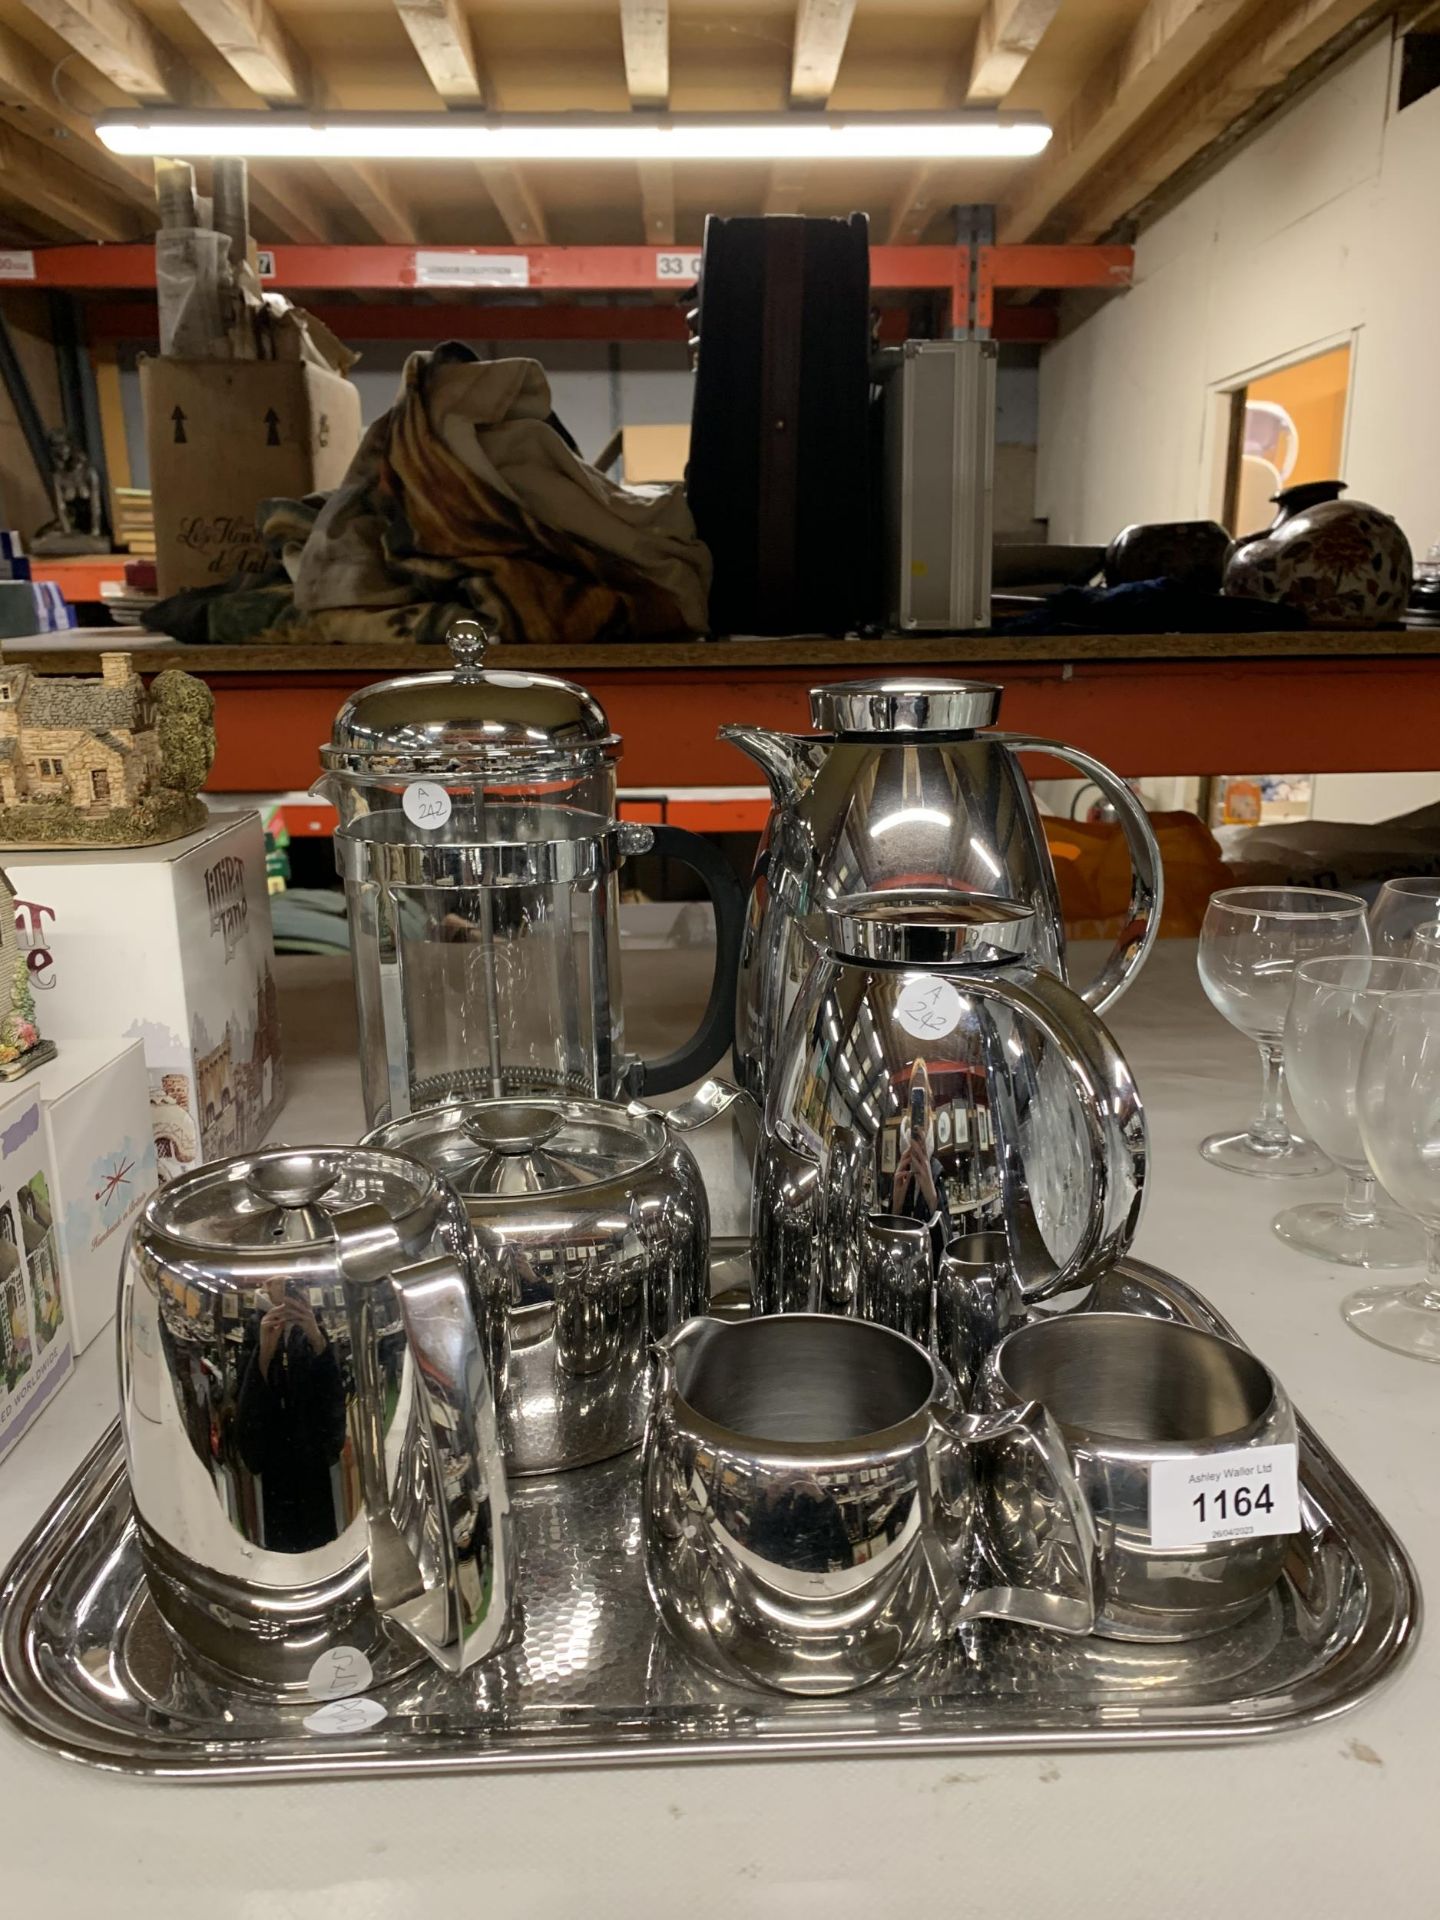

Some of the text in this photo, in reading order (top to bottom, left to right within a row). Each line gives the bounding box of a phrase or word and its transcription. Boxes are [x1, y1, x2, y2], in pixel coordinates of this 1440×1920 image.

[660, 257, 683, 274] 33
[417, 787, 430, 800] A
[924, 986, 943, 1005] A
[13, 1346, 59, 1406] WORLDWIDE
[1188, 1471, 1221, 1484] Ashley
[1256, 1463, 1273, 1474] Ltd
[1192, 1483, 1275, 1523] 1164
